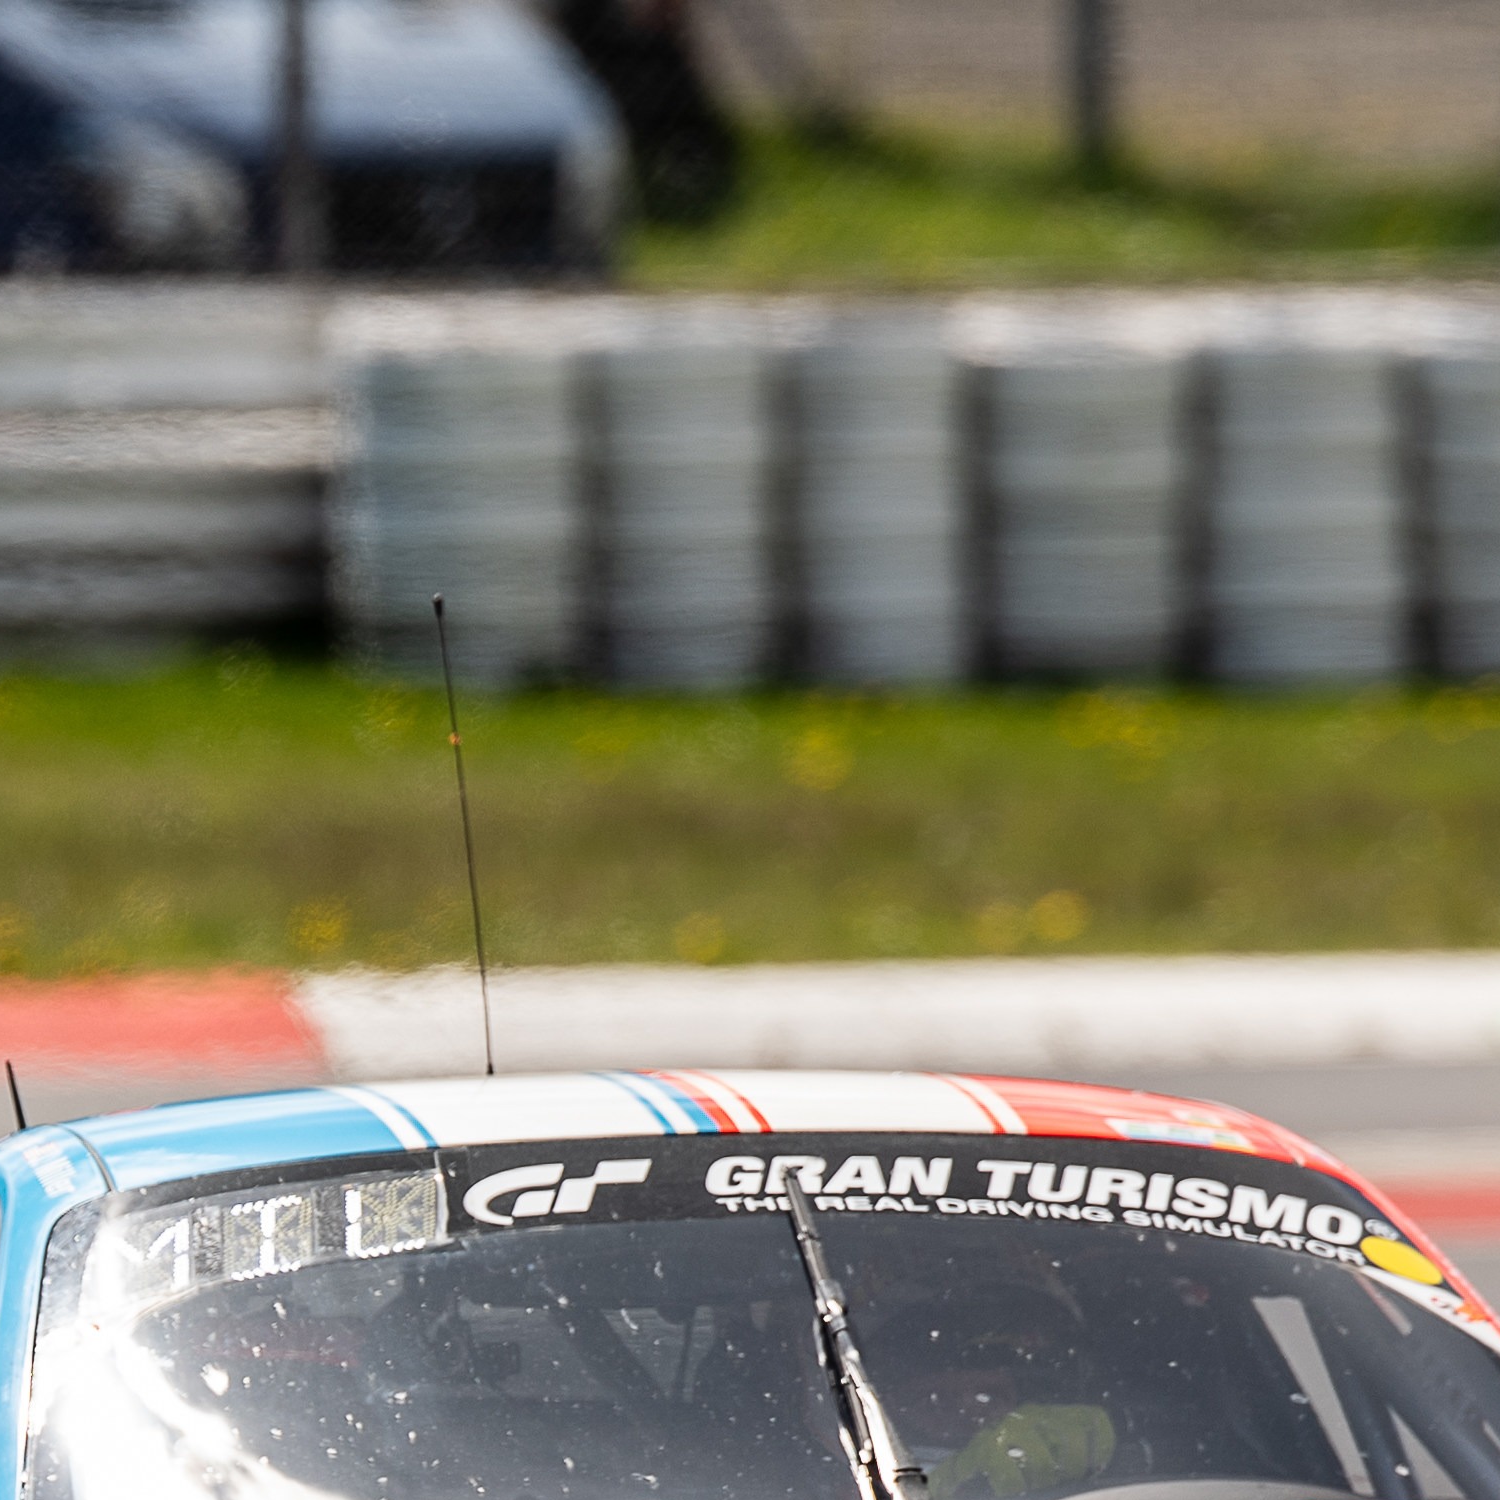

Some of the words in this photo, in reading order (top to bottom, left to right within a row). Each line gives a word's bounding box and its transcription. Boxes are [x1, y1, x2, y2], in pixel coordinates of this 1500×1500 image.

[704, 1155, 954, 1197] GRAN
[814, 1196, 930, 1212] REAL
[935, 1197, 1114, 1223] DRIVING
[1122, 1210, 1365, 1267] SIMULATOR
